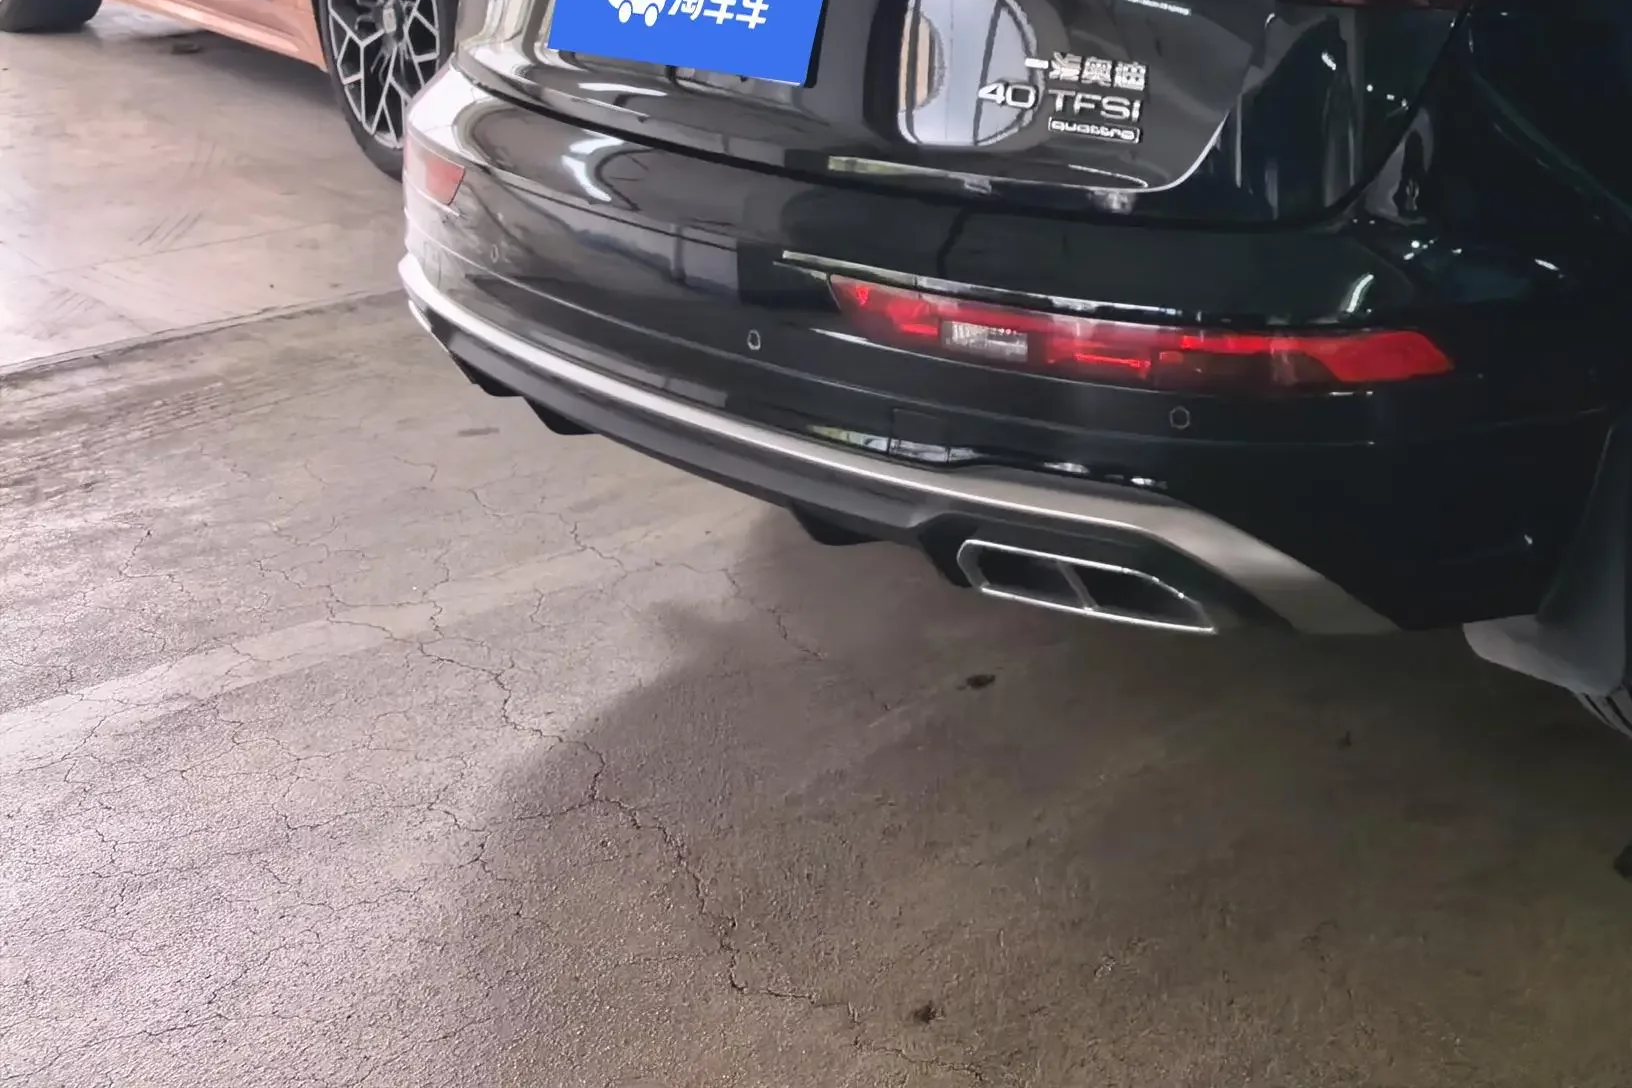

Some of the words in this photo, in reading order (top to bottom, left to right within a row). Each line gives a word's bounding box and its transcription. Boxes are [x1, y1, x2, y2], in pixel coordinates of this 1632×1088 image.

[978, 81, 1037, 110] 40
[1048, 88, 1141, 123] TFSI
[1050, 119, 1136, 141] quattro
